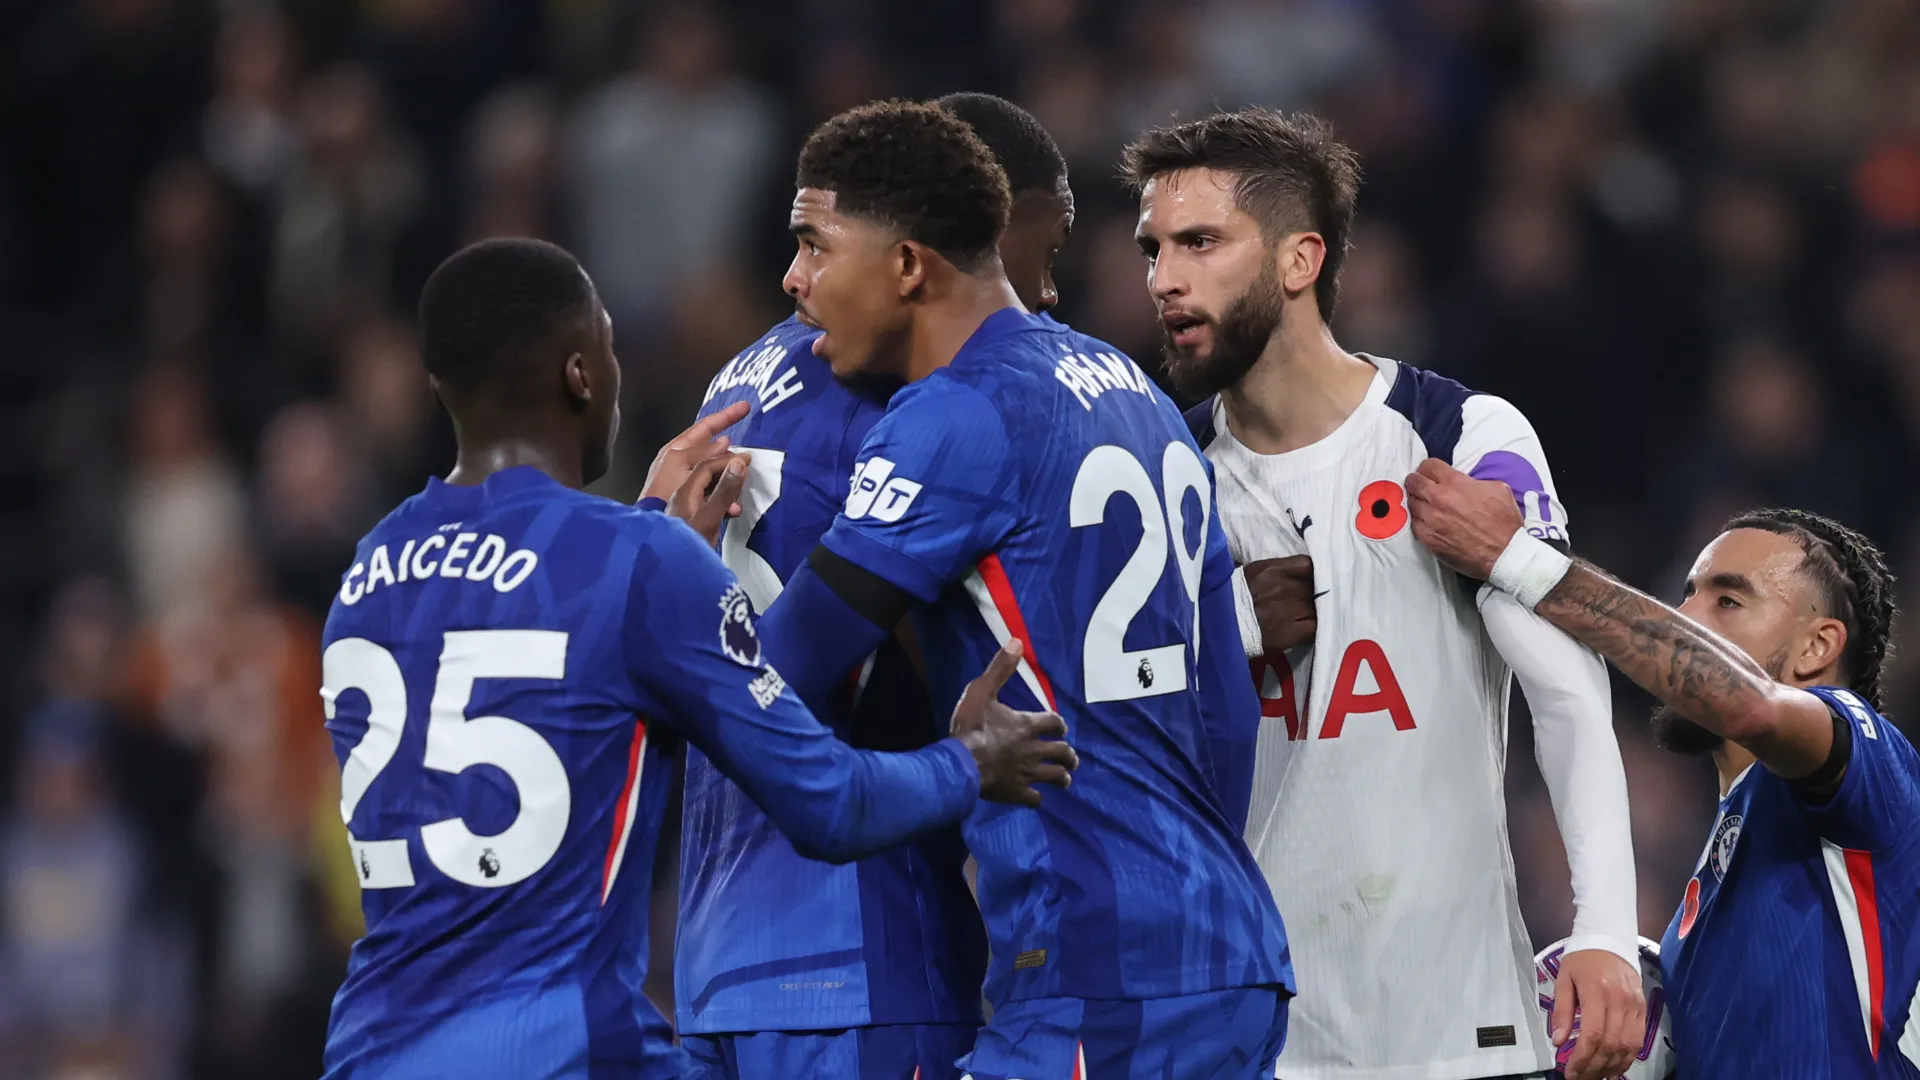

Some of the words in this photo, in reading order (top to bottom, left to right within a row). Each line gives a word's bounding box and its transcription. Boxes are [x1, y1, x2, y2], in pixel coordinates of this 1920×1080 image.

[702, 345, 804, 414] ALOBAH
[1055, 353, 1157, 412] FOFANA
[844, 456, 924, 522] PT
[340, 532, 538, 606] CAICEDO
[1069, 440, 1211, 704] 29
[319, 629, 571, 888] 25
